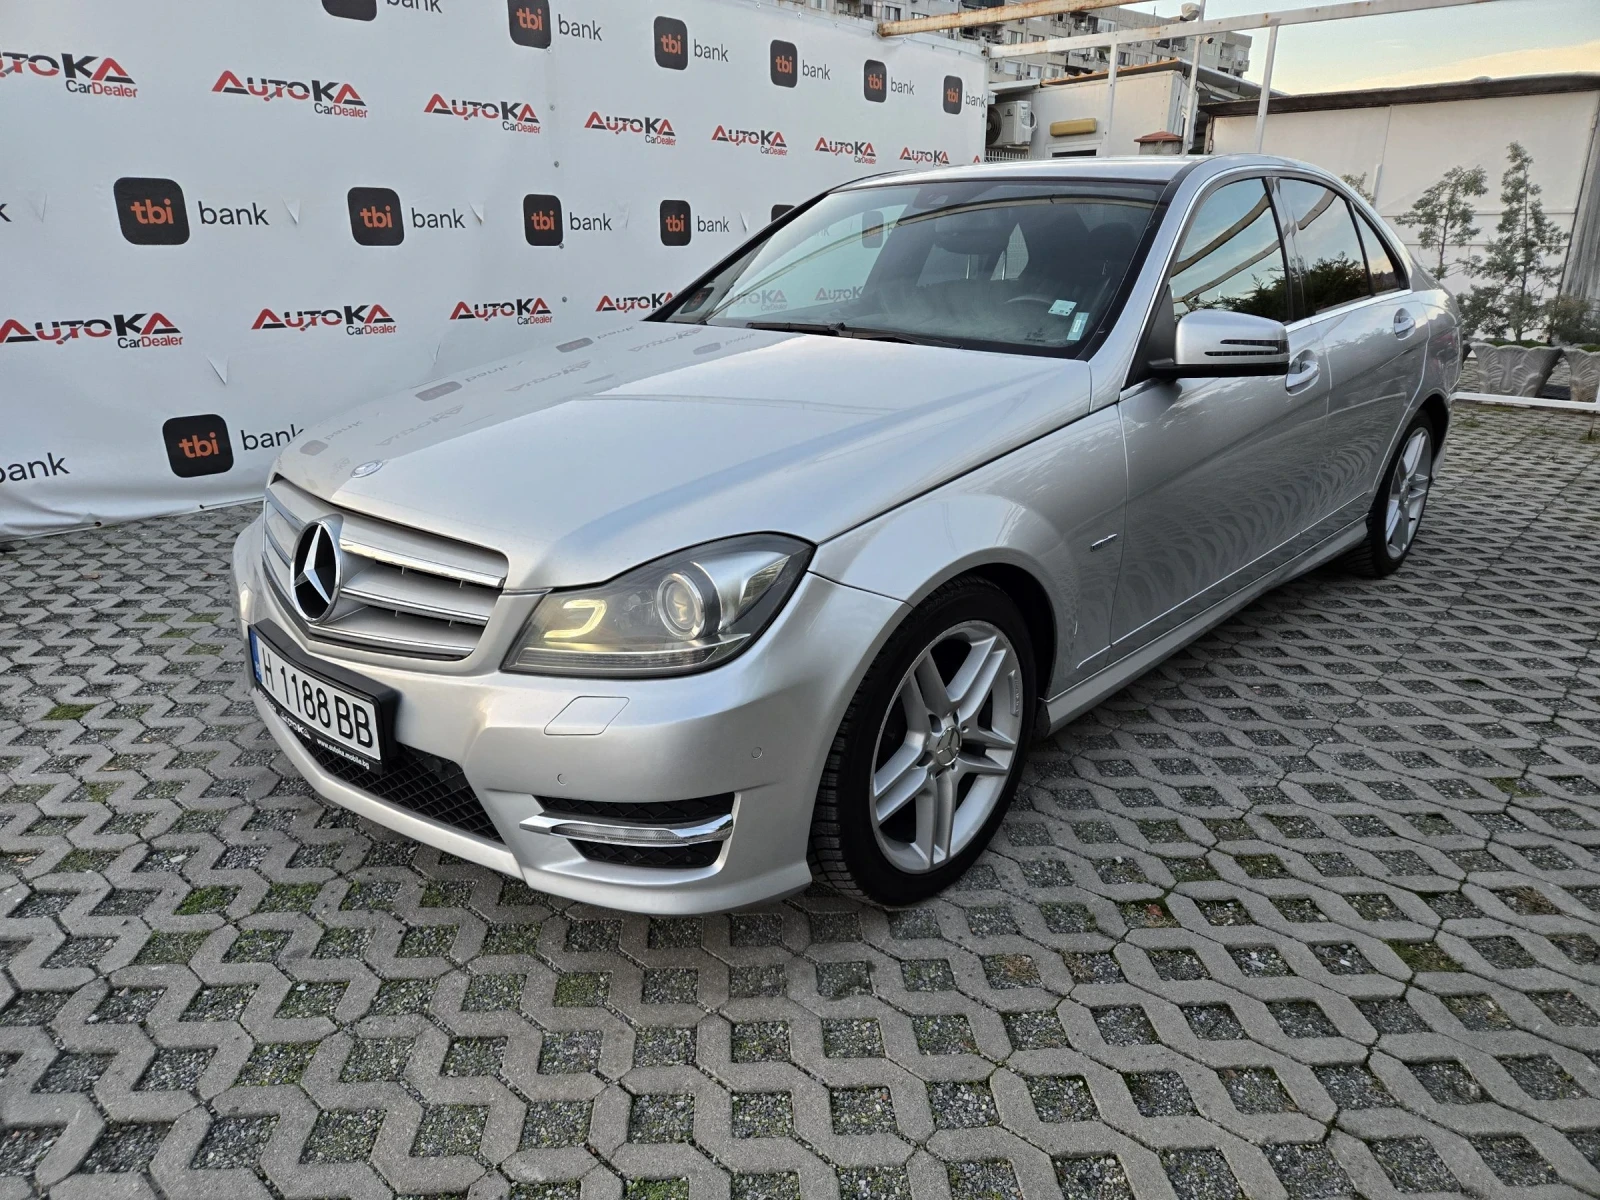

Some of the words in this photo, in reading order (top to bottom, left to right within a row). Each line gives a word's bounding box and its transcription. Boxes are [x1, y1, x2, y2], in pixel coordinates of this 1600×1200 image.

[517, 9, 543, 30] tbi
[558, 14, 602, 41] bank
[661, 36, 681, 54] tbi
[694, 39, 728, 62] bank
[0, 52, 136, 85] TOKA
[776, 57, 792, 73] tbi
[803, 60, 830, 80] bank
[65, 79, 138, 98] CarDealer
[868, 75, 882, 89] tbi
[891, 78, 914, 95] bank
[947, 90, 958, 102] tbi
[966, 92, 986, 108] bank
[314, 102, 368, 118] CarDealer
[502, 120, 541, 134] CarDealer
[645, 134, 676, 146] CarDealer
[130, 198, 174, 224] tbi
[198, 201, 269, 225] bank
[360, 205, 393, 228] tbi
[412, 208, 466, 228] bank
[532, 212, 555, 231] tbi
[570, 212, 612, 230] bank
[666, 216, 685, 232] tbi
[698, 216, 729, 232] bank
[346, 322, 397, 337] CarDealer
[517, 314, 553, 326] CarDealer
[117, 335, 183, 349] CarDealer
[179, 432, 219, 458] tbi
[262, 647, 275, 691] H
[280, 665, 331, 729] 1188
[334, 694, 373, 749] BB
